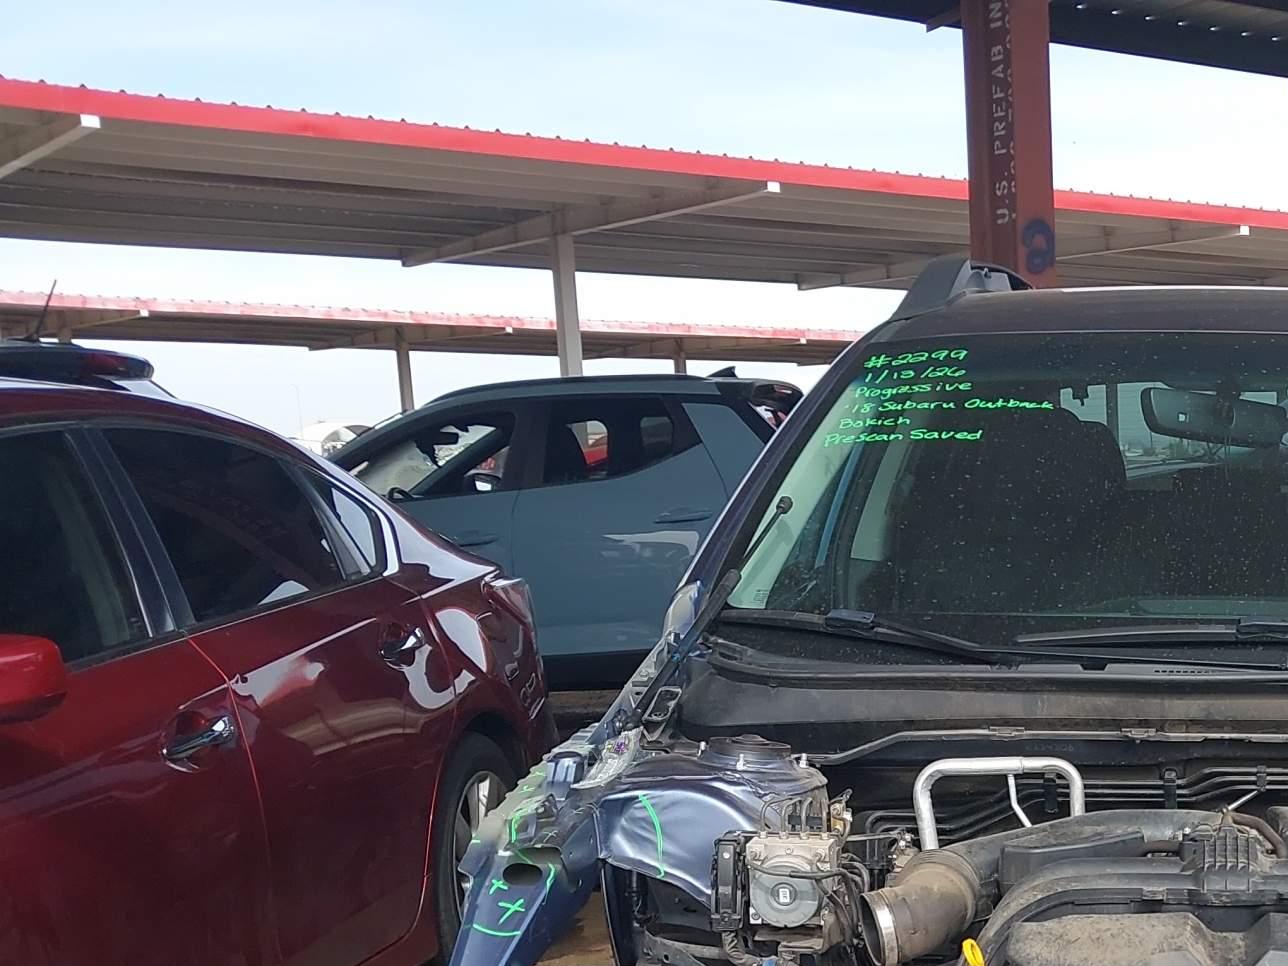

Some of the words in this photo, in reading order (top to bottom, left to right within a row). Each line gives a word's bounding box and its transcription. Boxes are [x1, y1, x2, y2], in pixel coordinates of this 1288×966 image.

[991, 44, 1007, 155] PREFAB
[995, 171, 1010, 225] U.S.
[863, 349, 968, 368] #2299
[878, 400, 956, 412] Subaru
[824, 432, 904, 447] Prescan
[909, 428, 983, 441] Saved
